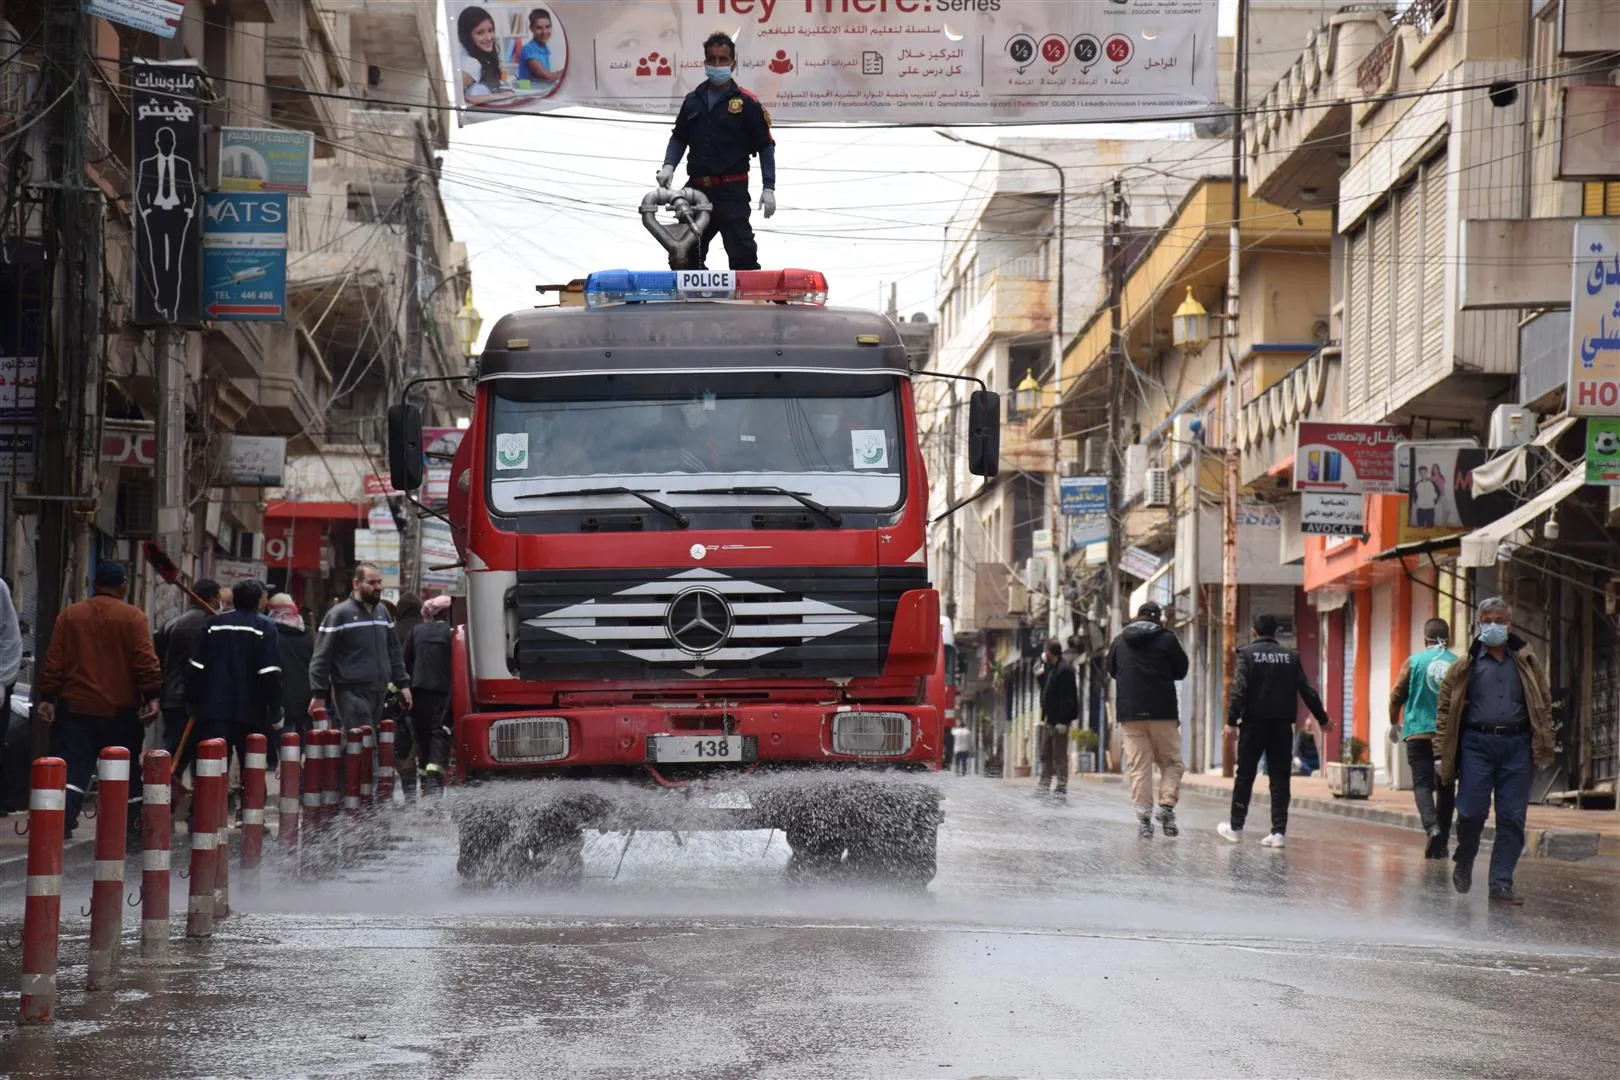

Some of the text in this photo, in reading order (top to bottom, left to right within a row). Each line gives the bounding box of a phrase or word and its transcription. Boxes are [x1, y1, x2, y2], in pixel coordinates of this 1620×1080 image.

[843, 25, 868, 34] اللغة
[870, 25, 902, 36] لتعليم
[905, 25, 941, 34] سلسلة
[897, 48, 964, 61] التركيز خلال
[1143, 57, 1178, 70] المراحل
[898, 65, 962, 77] كل درس على
[135, 72, 195, 92] ملبوسات
[138, 97, 194, 122] هيثم
[683, 273, 729, 287] POLICE
[1578, 382, 1620, 406] HO
[1306, 523, 1354, 535] AVOCAT
[694, 740, 729, 757] 138
